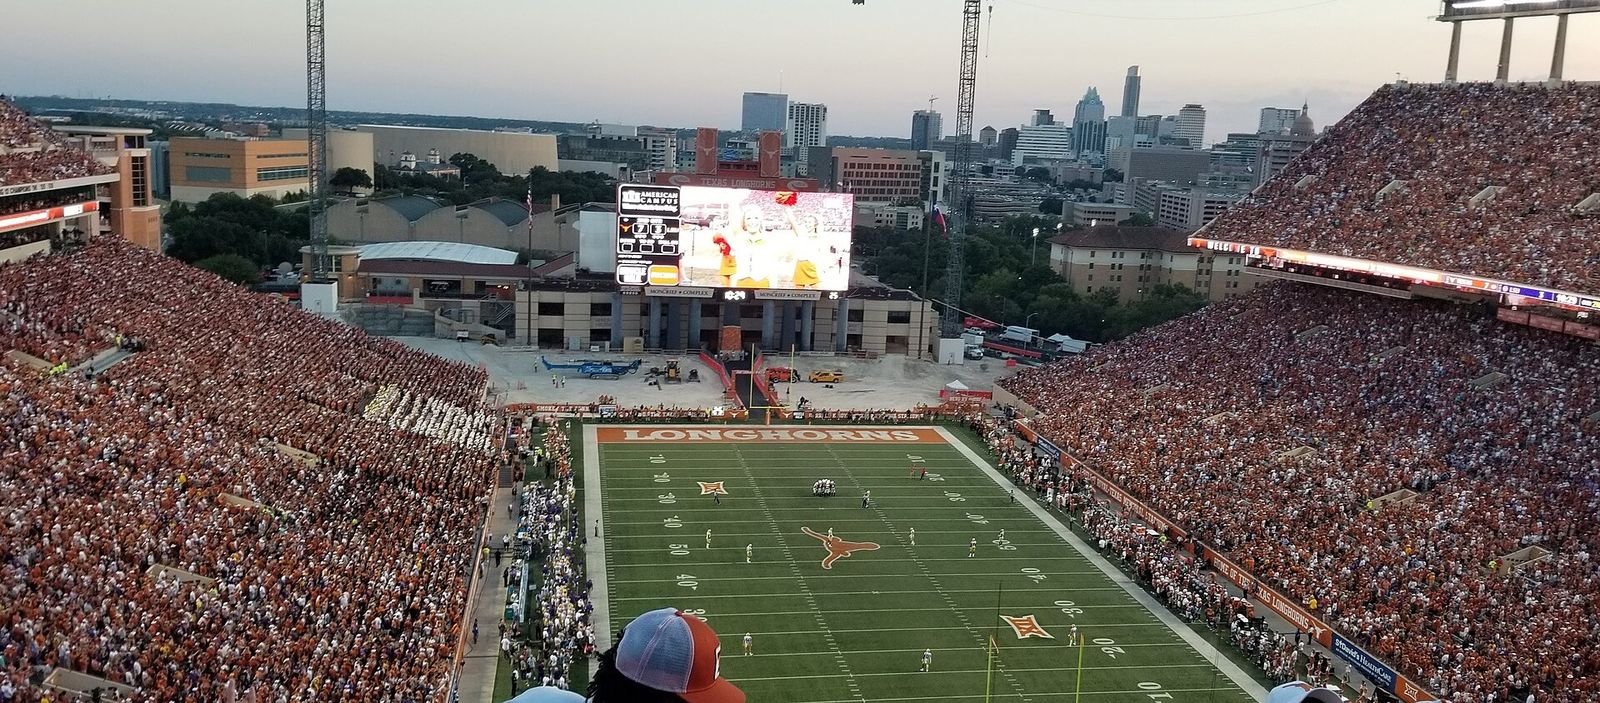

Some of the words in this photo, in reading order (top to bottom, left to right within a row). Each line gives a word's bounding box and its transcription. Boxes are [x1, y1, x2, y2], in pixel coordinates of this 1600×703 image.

[700, 178, 727, 187] TEXAS
[732, 179, 775, 189] LONGHORNS
[641, 191, 678, 199] AMERICAN
[623, 429, 920, 441] LONGHORNS
[669, 544, 690, 556] 50
[676, 574, 699, 588] 40
[1021, 567, 1047, 581] 40
[1213, 557, 1229, 576] HOME
[1229, 572, 1238, 582] OF
[1272, 596, 1309, 629] LONGHORNS
[1054, 600, 1083, 615] 30
[1092, 638, 1126, 656] 20
[1137, 681, 1174, 701] 10
